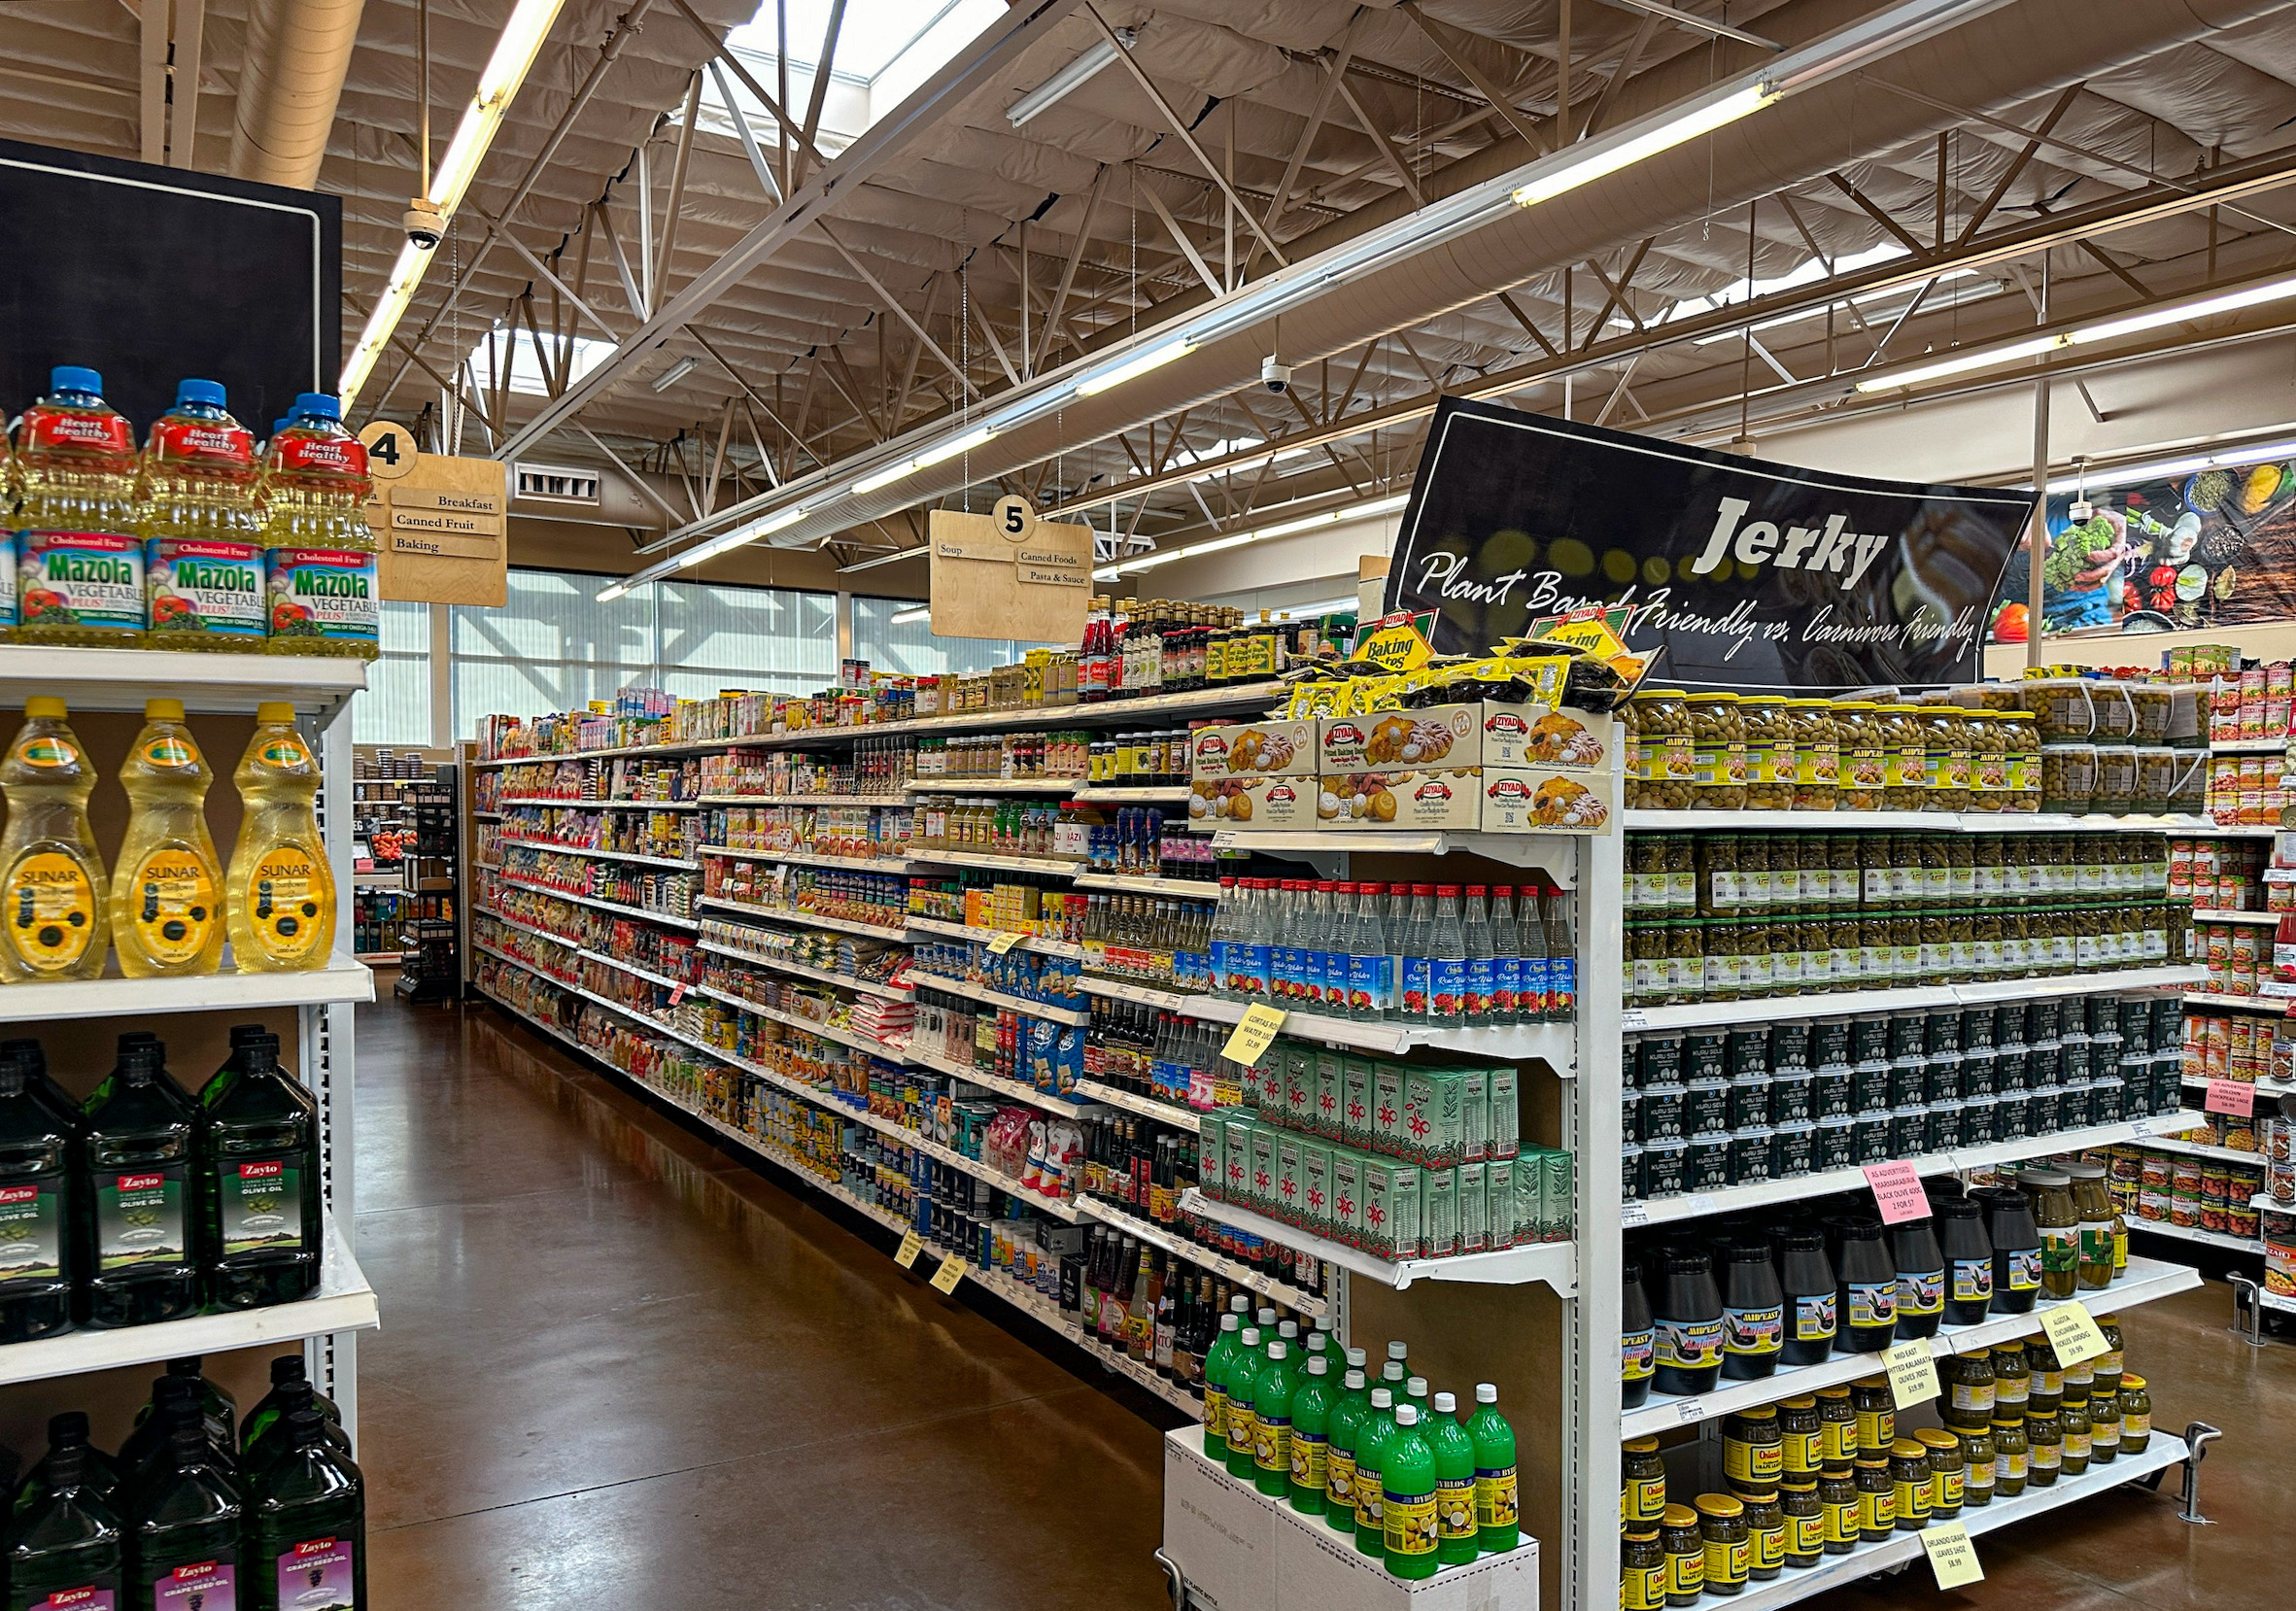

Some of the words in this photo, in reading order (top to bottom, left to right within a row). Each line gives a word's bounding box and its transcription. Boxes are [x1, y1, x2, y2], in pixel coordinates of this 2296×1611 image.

[61, 418, 102, 429] Heart
[52, 426, 112, 441] Healthy
[190, 429, 229, 441] Heart
[183, 437, 237, 452] Healthy
[305, 441, 342, 453] Heart
[369, 432, 400, 465] 4
[298, 450, 350, 463] Healthy
[437, 497, 493, 510] Breakfast
[396, 515, 442, 529] Canned
[445, 519, 475, 531] Fruit
[1005, 506, 1024, 532] 5
[50, 535, 103, 548] Cholesterol
[106, 538, 124, 548] Free
[396, 538, 439, 554] Baking
[1692, 497, 1889, 590] Jerky
[179, 545, 229, 556] Cholesterol
[231, 548, 249, 557] Free
[941, 544, 962, 556] Soup
[297, 553, 343, 564] Cholesterol
[345, 556, 361, 565] Free
[1020, 552, 1052, 563] Canned
[1054, 555, 1078, 565] Foods
[49, 554, 133, 586] Mazola
[178, 561, 256, 593] Mazola
[1030, 571, 1051, 581] Pasta
[1063, 575, 1085, 584] Sauce
[295, 569, 368, 599] Mazola
[66, 584, 144, 601] VEGETABLE
[70, 598, 104, 608] PLUS!
[194, 591, 265, 608] VEGETABLE
[198, 604, 230, 614] PLUS!
[312, 598, 378, 614] VEGETABLE
[1417, 551, 1526, 605] Plant
[1630, 588, 1758, 661] Friendly
[1801, 604, 1899, 642] Carnivore
[1899, 604, 1975, 664] Friendly
[316, 612, 345, 621] PLUS!
[1387, 613, 1406, 625] ZIYAD
[1571, 608, 1596, 620] ZIYAD
[1366, 637, 1415, 659] Baking
[1496, 717, 1518, 727] ZIYAD
[1335, 728, 1353, 738] ZIYAD
[1424, 785, 1442, 794] ZIYAD
[1500, 783, 1521, 792] ZIYAD
[147, 867, 199, 878] SUNAR
[261, 865, 311, 875] SUNAR
[23, 871, 79, 882] SUNAR
[1249, 1014, 1270, 1027] CORTAS
[1244, 1026, 1263, 1038] WATER
[1246, 1039, 1260, 1049] $2.99
[245, 1166, 278, 1176] Zayto
[1879, 1166, 1910, 1177] ADVERTISED
[124, 1178, 158, 1189] Zayto
[1877, 1191, 1894, 1201] BLACK
[1894, 1189, 1909, 1198] OLIVE
[120, 1200, 147, 1209] OLIVE
[2054, 1323, 2080, 1338] CUCUMBER
[2056, 1338, 2073, 1349] PICKLES
[1894, 1351, 1905, 1360] MID
[1905, 1347, 1918, 1357] EAST
[2069, 1345, 2083, 1356] $9.99
[1889, 1364, 1905, 1375] PITTED
[1905, 1356, 1933, 1369] KALAMATA
[1899, 1372, 1916, 1385] OLIVES
[1908, 1382, 1925, 1393] $19.99
[1358, 1468, 1382, 1480] BYBLO
[1926, 1537, 1950, 1548] ORLANDO
[1951, 1533, 1967, 1543] GRAPE
[301, 1541, 331, 1554] Zayto
[1936, 1547, 1953, 1559] LEAVES
[287, 1562, 312, 1572] GRAPE
[314, 1559, 331, 1567] SEED
[1948, 1559, 1962, 1568] $8.99
[179, 1564, 213, 1578] Zayto
[164, 1586, 191, 1596] GRAPE
[193, 1583, 210, 1592] SEED
[54, 1590, 90, 1604] Zayto
